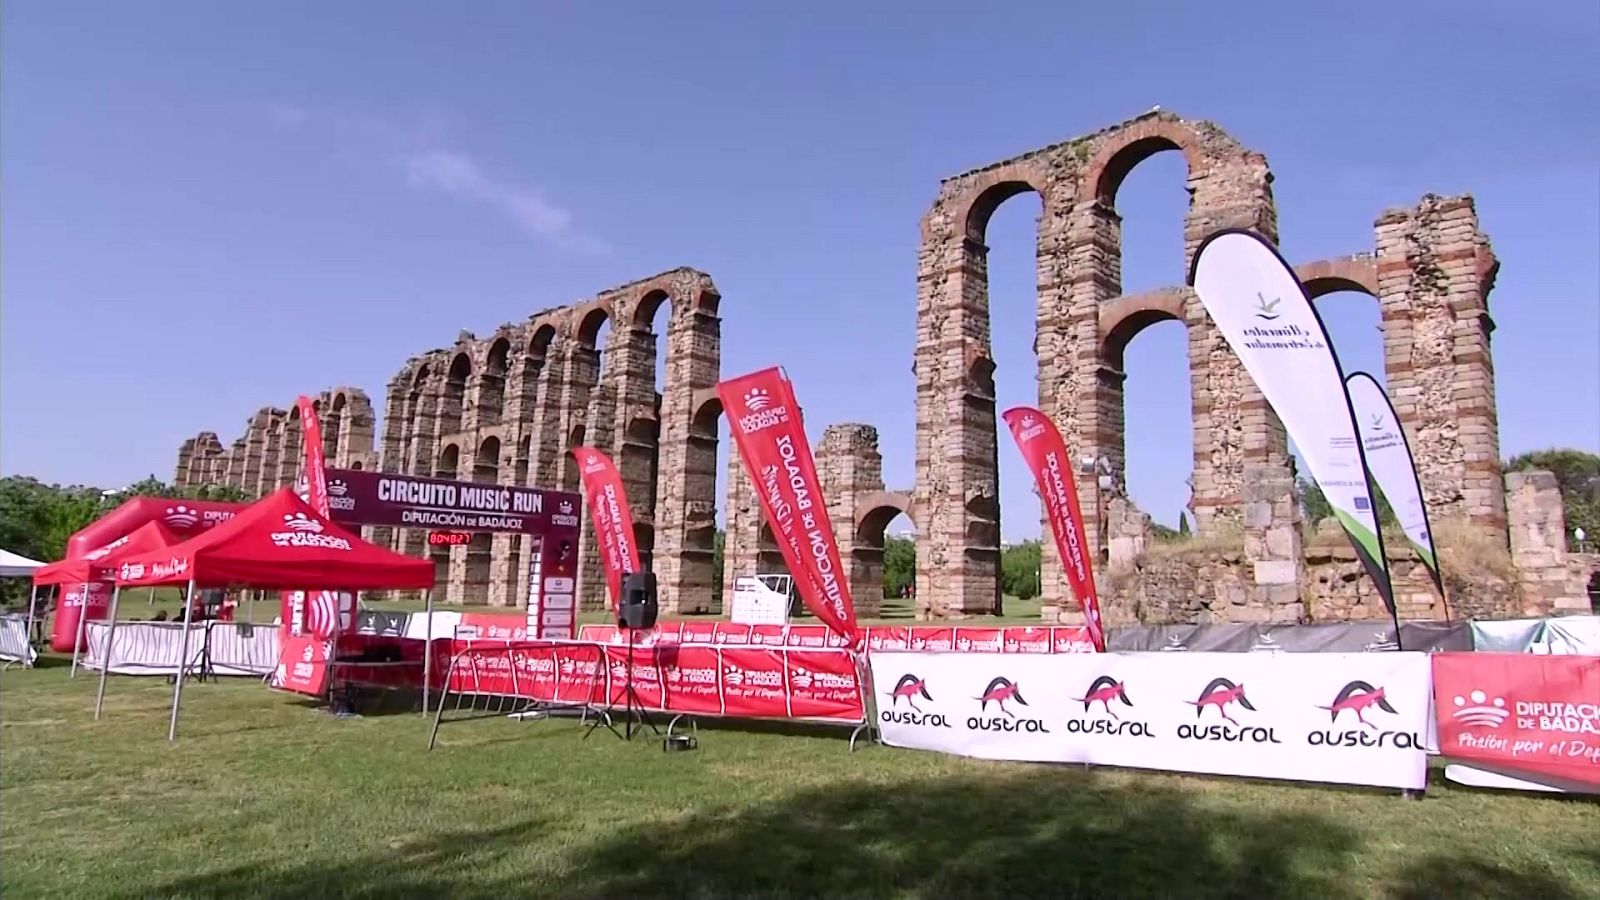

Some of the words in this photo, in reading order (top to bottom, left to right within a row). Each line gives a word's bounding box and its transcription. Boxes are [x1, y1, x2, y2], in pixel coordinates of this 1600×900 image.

[378, 479, 456, 506] CIRCUITO
[460, 487, 510, 511] MUSIC
[513, 492, 543, 513] RUN
[402, 511, 466, 526] DIPUTACIÓN
[478, 516, 523, 530] BADAJOZ
[881, 710, 952, 729] austral
[1516, 701, 1600, 720] DIPUTACI
[967, 716, 1050, 734] austral
[1067, 719, 1156, 738] austral
[1517, 717, 1536, 729] DE
[1177, 724, 1283, 744] austral
[1307, 729, 1427, 752] austral
[1458, 732, 1508, 751] Pasión
[1512, 740, 1544, 757] por
[1549, 741, 1566, 756] el
